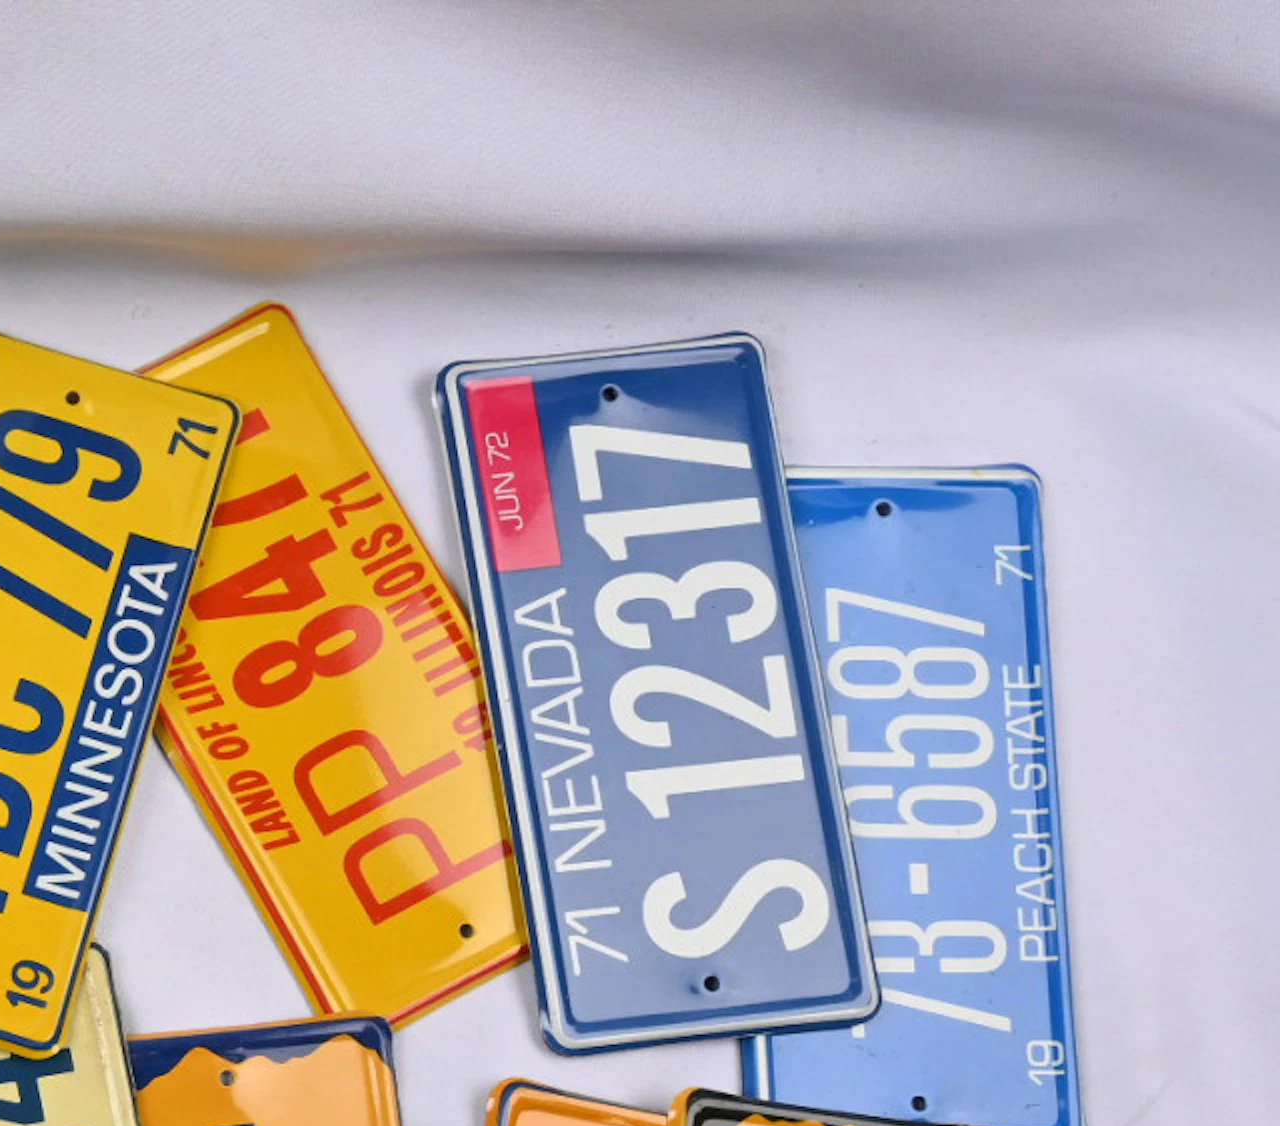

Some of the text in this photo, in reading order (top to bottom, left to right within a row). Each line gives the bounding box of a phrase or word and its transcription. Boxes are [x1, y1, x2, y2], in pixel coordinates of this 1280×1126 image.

[168, 417, 218, 458] 71
[485, 431, 523, 531] JUN 72
[320, 471, 372, 528] 71
[995, 545, 1033, 584] 71
[352, 525, 484, 700] ILLINOIS
[35, 559, 178, 900] MINNESOTA
[569, 425, 831, 959] S 12317
[195, 715, 251, 760] OF
[514, 587, 629, 976] 71 NEVADA
[226, 772, 299, 851] LAND
[293, 728, 513, 926] PP
[1004, 664, 1059, 961] PEACH STATE
[6, 958, 57, 1009] 19
[1027, 1037, 1064, 1085] 19
